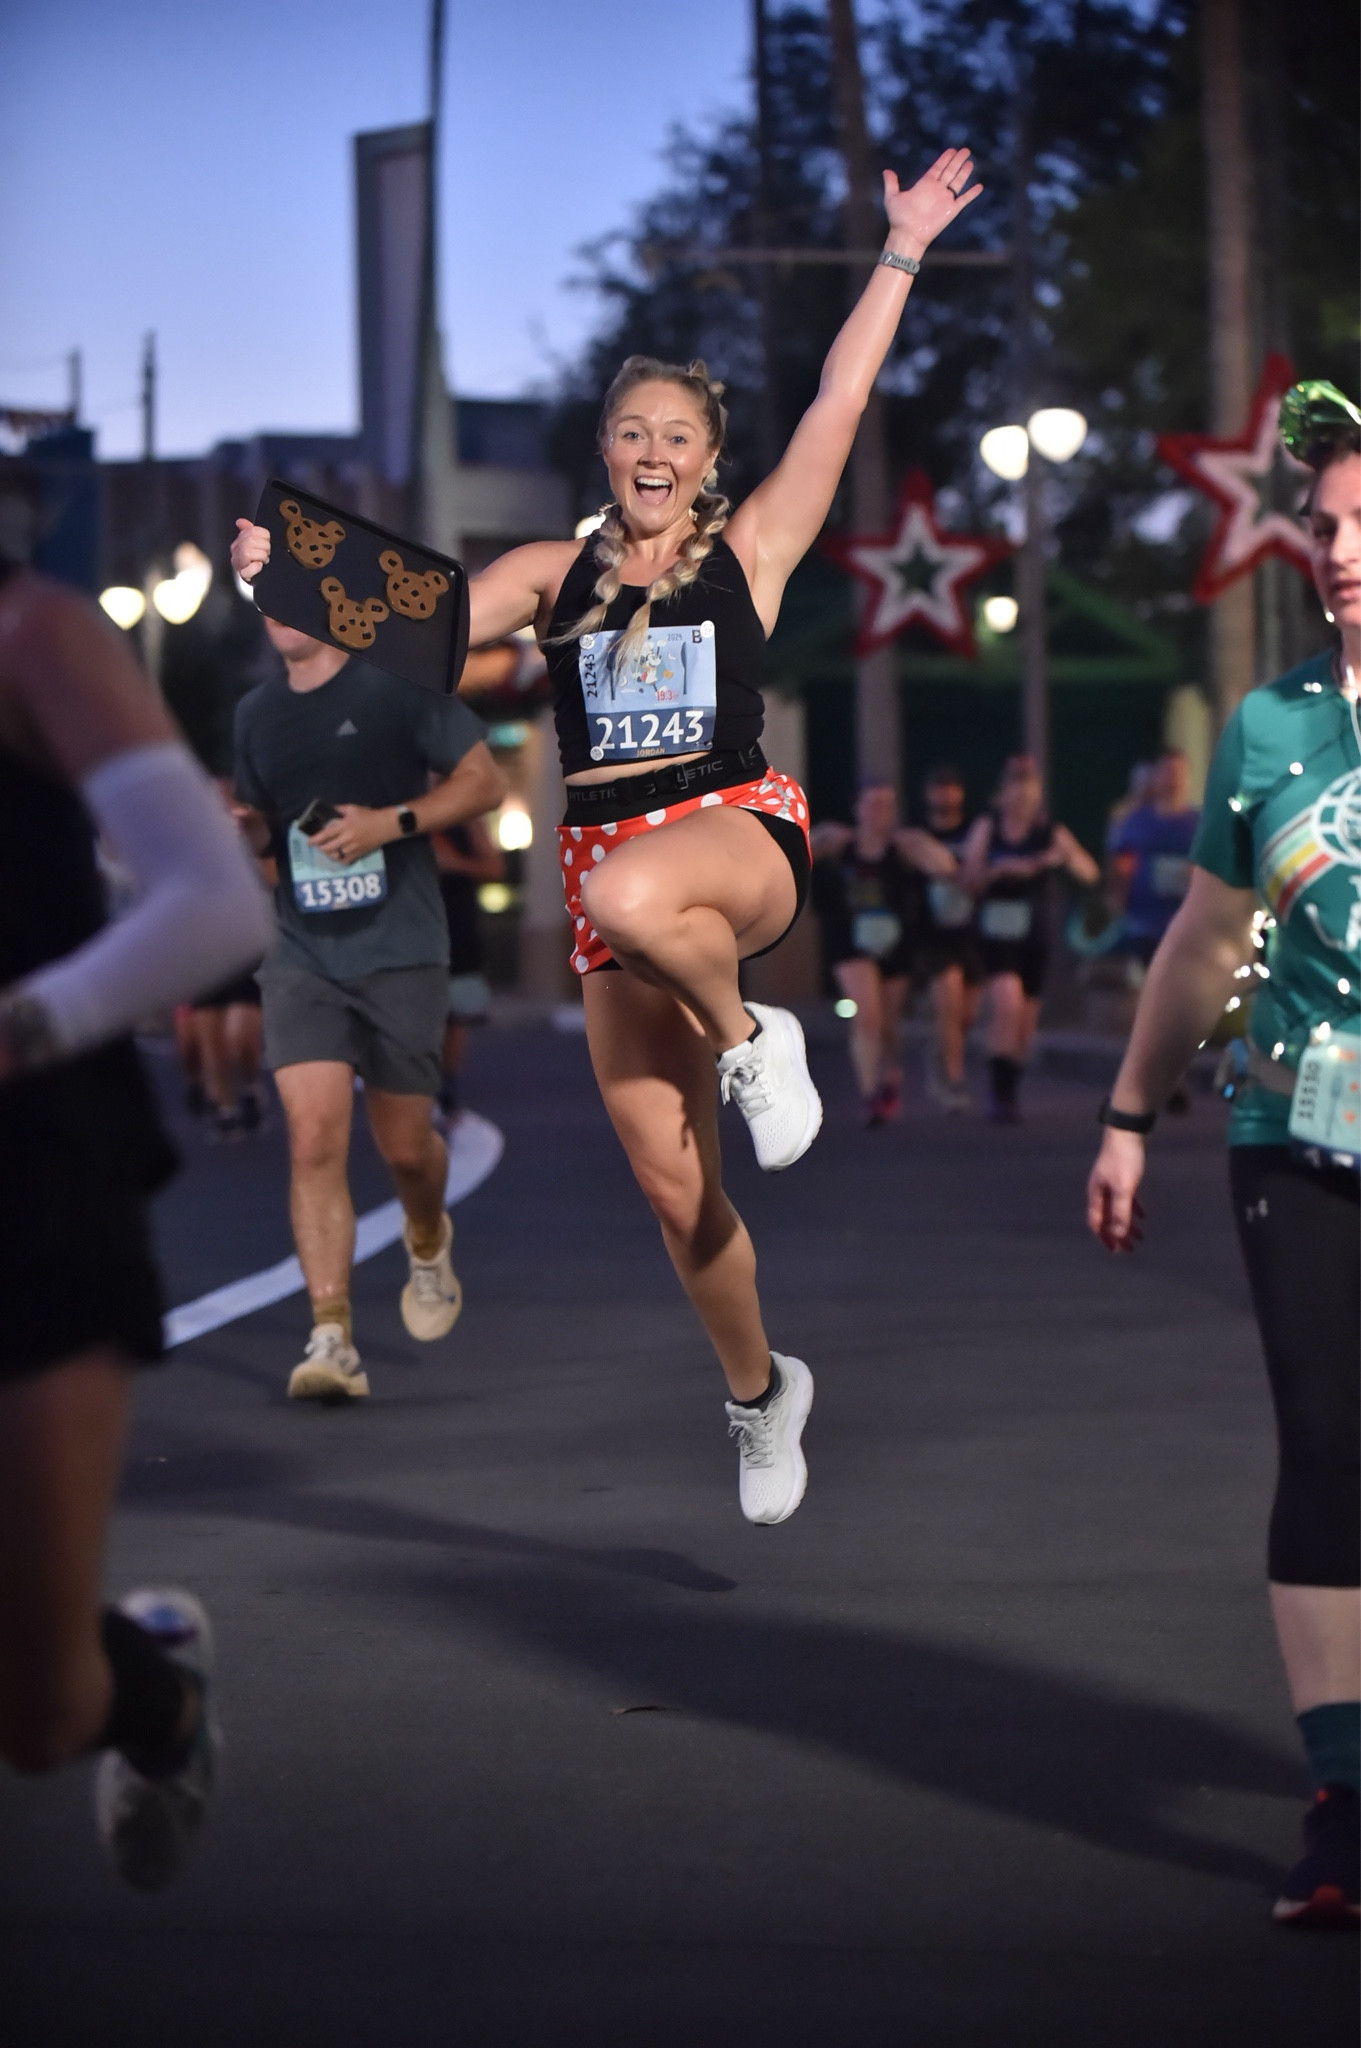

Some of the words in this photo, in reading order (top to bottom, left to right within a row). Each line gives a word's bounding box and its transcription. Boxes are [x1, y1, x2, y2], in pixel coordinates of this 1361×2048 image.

[692, 629, 702, 643] B
[583, 653, 598, 699] 21243
[596, 711, 704, 750] 21243
[636, 747, 665, 757] JORDAN
[301, 873, 381, 907] 15308
